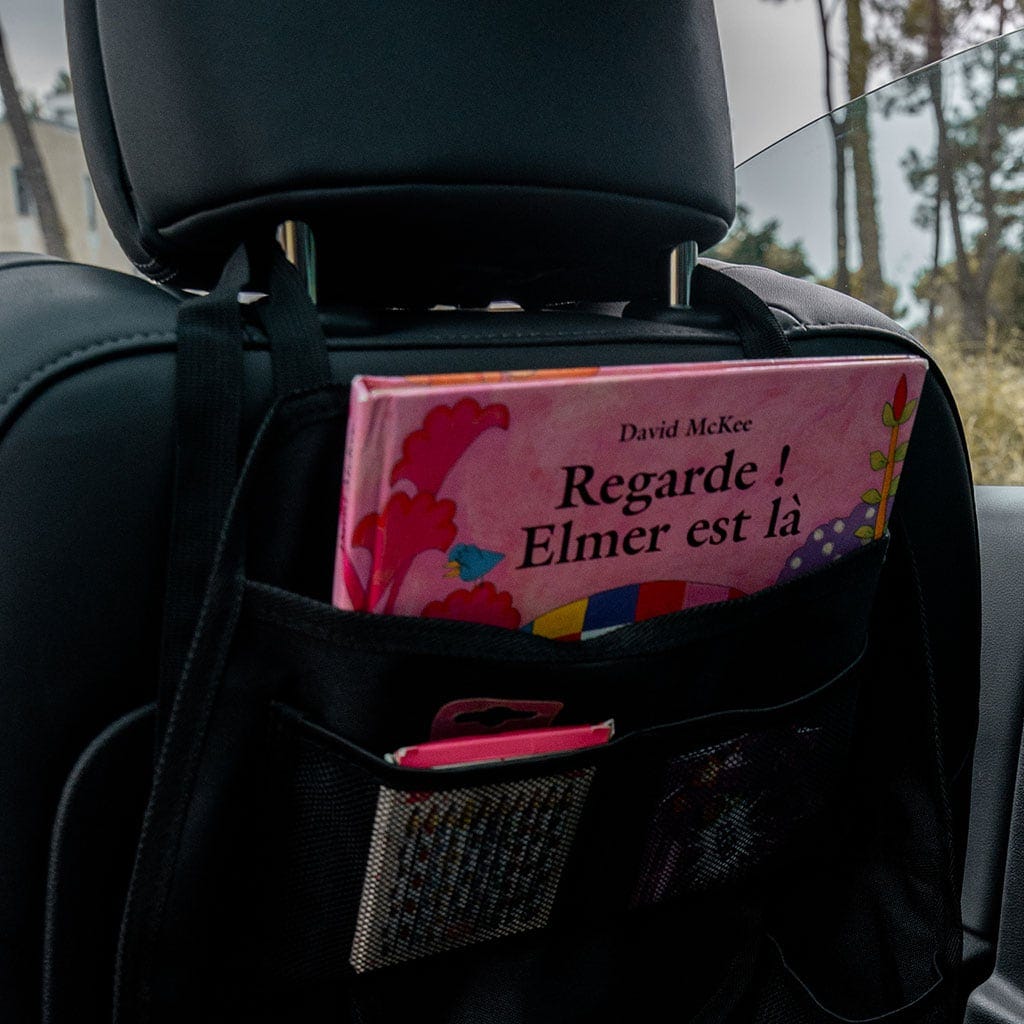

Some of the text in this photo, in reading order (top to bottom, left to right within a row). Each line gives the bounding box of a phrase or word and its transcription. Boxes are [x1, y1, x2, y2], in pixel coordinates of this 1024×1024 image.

[619, 415, 753, 442] David McKee
[555, 444, 791, 516] Regarde !
[515, 493, 802, 570] Elmer est là
